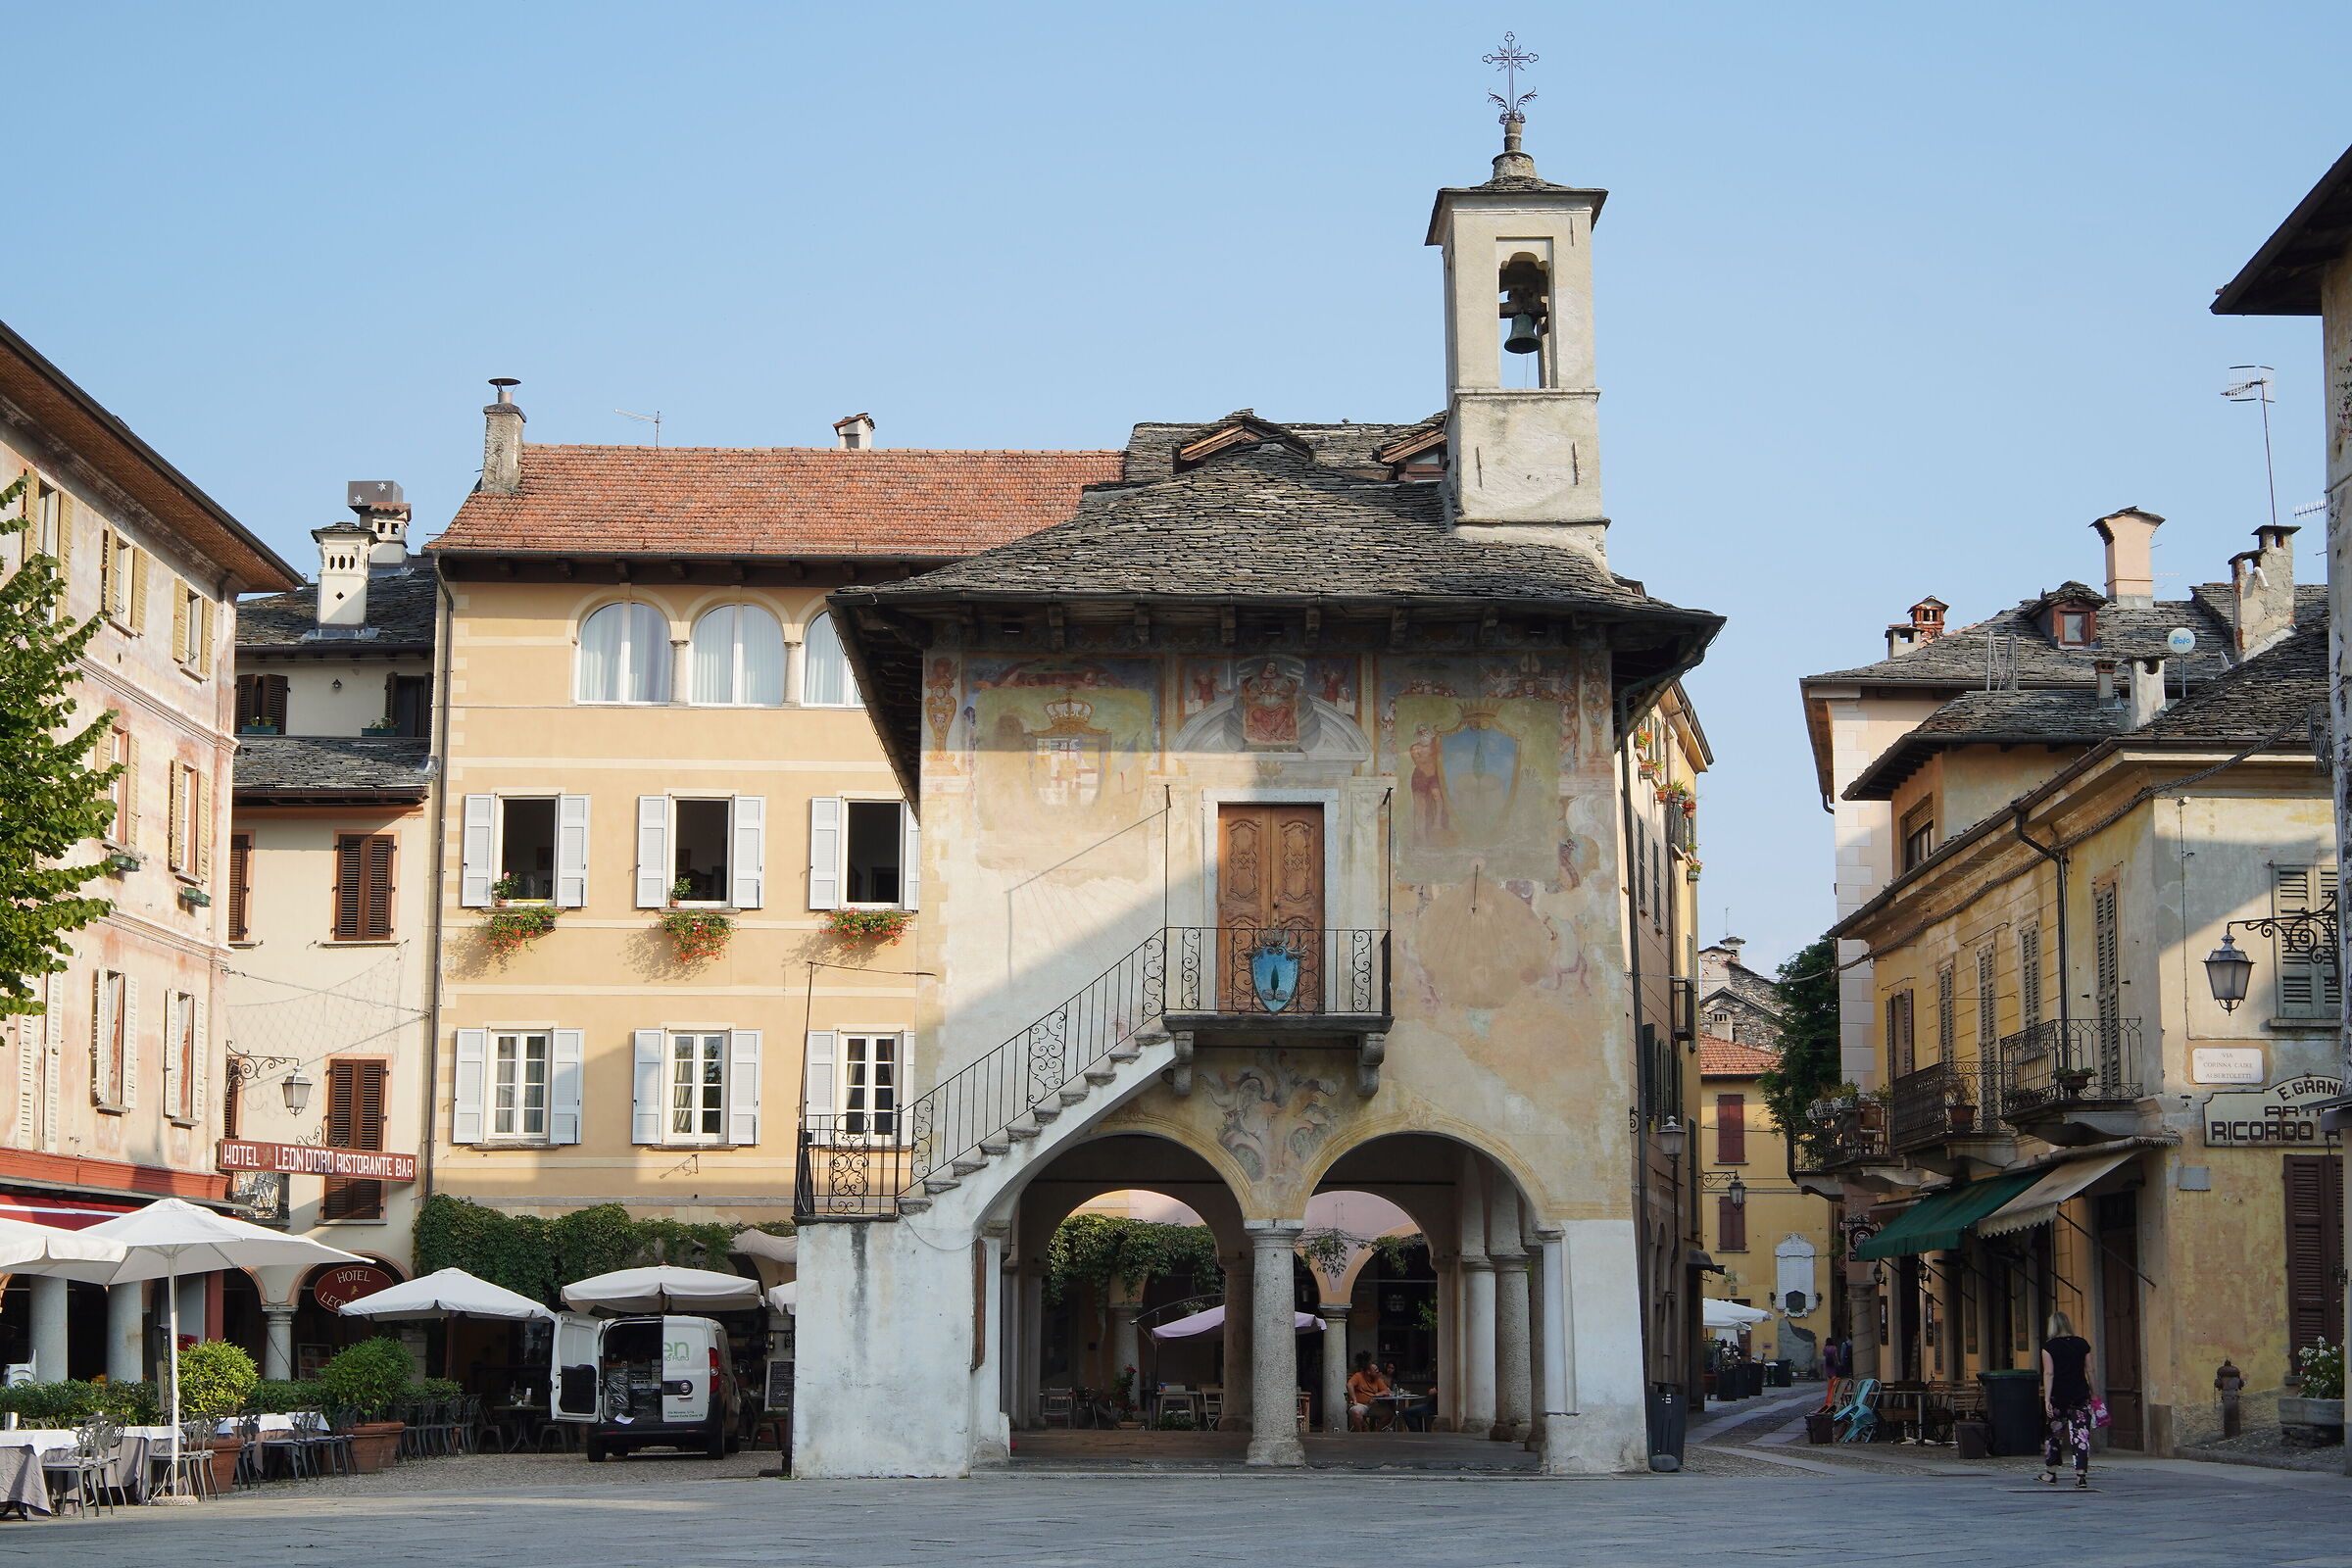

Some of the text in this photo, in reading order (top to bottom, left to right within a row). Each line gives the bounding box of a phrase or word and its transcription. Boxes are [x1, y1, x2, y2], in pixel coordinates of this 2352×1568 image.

[2211, 1121, 2314, 1141] RICORDO
[223, 1145, 260, 1167] HOTEL
[274, 1146, 304, 1172] LEON
[336, 1152, 393, 1177] RISTORANTE
[395, 1157, 414, 1178] BAR
[336, 1269, 370, 1284] HOTEL
[319, 1291, 350, 1309] LEO
